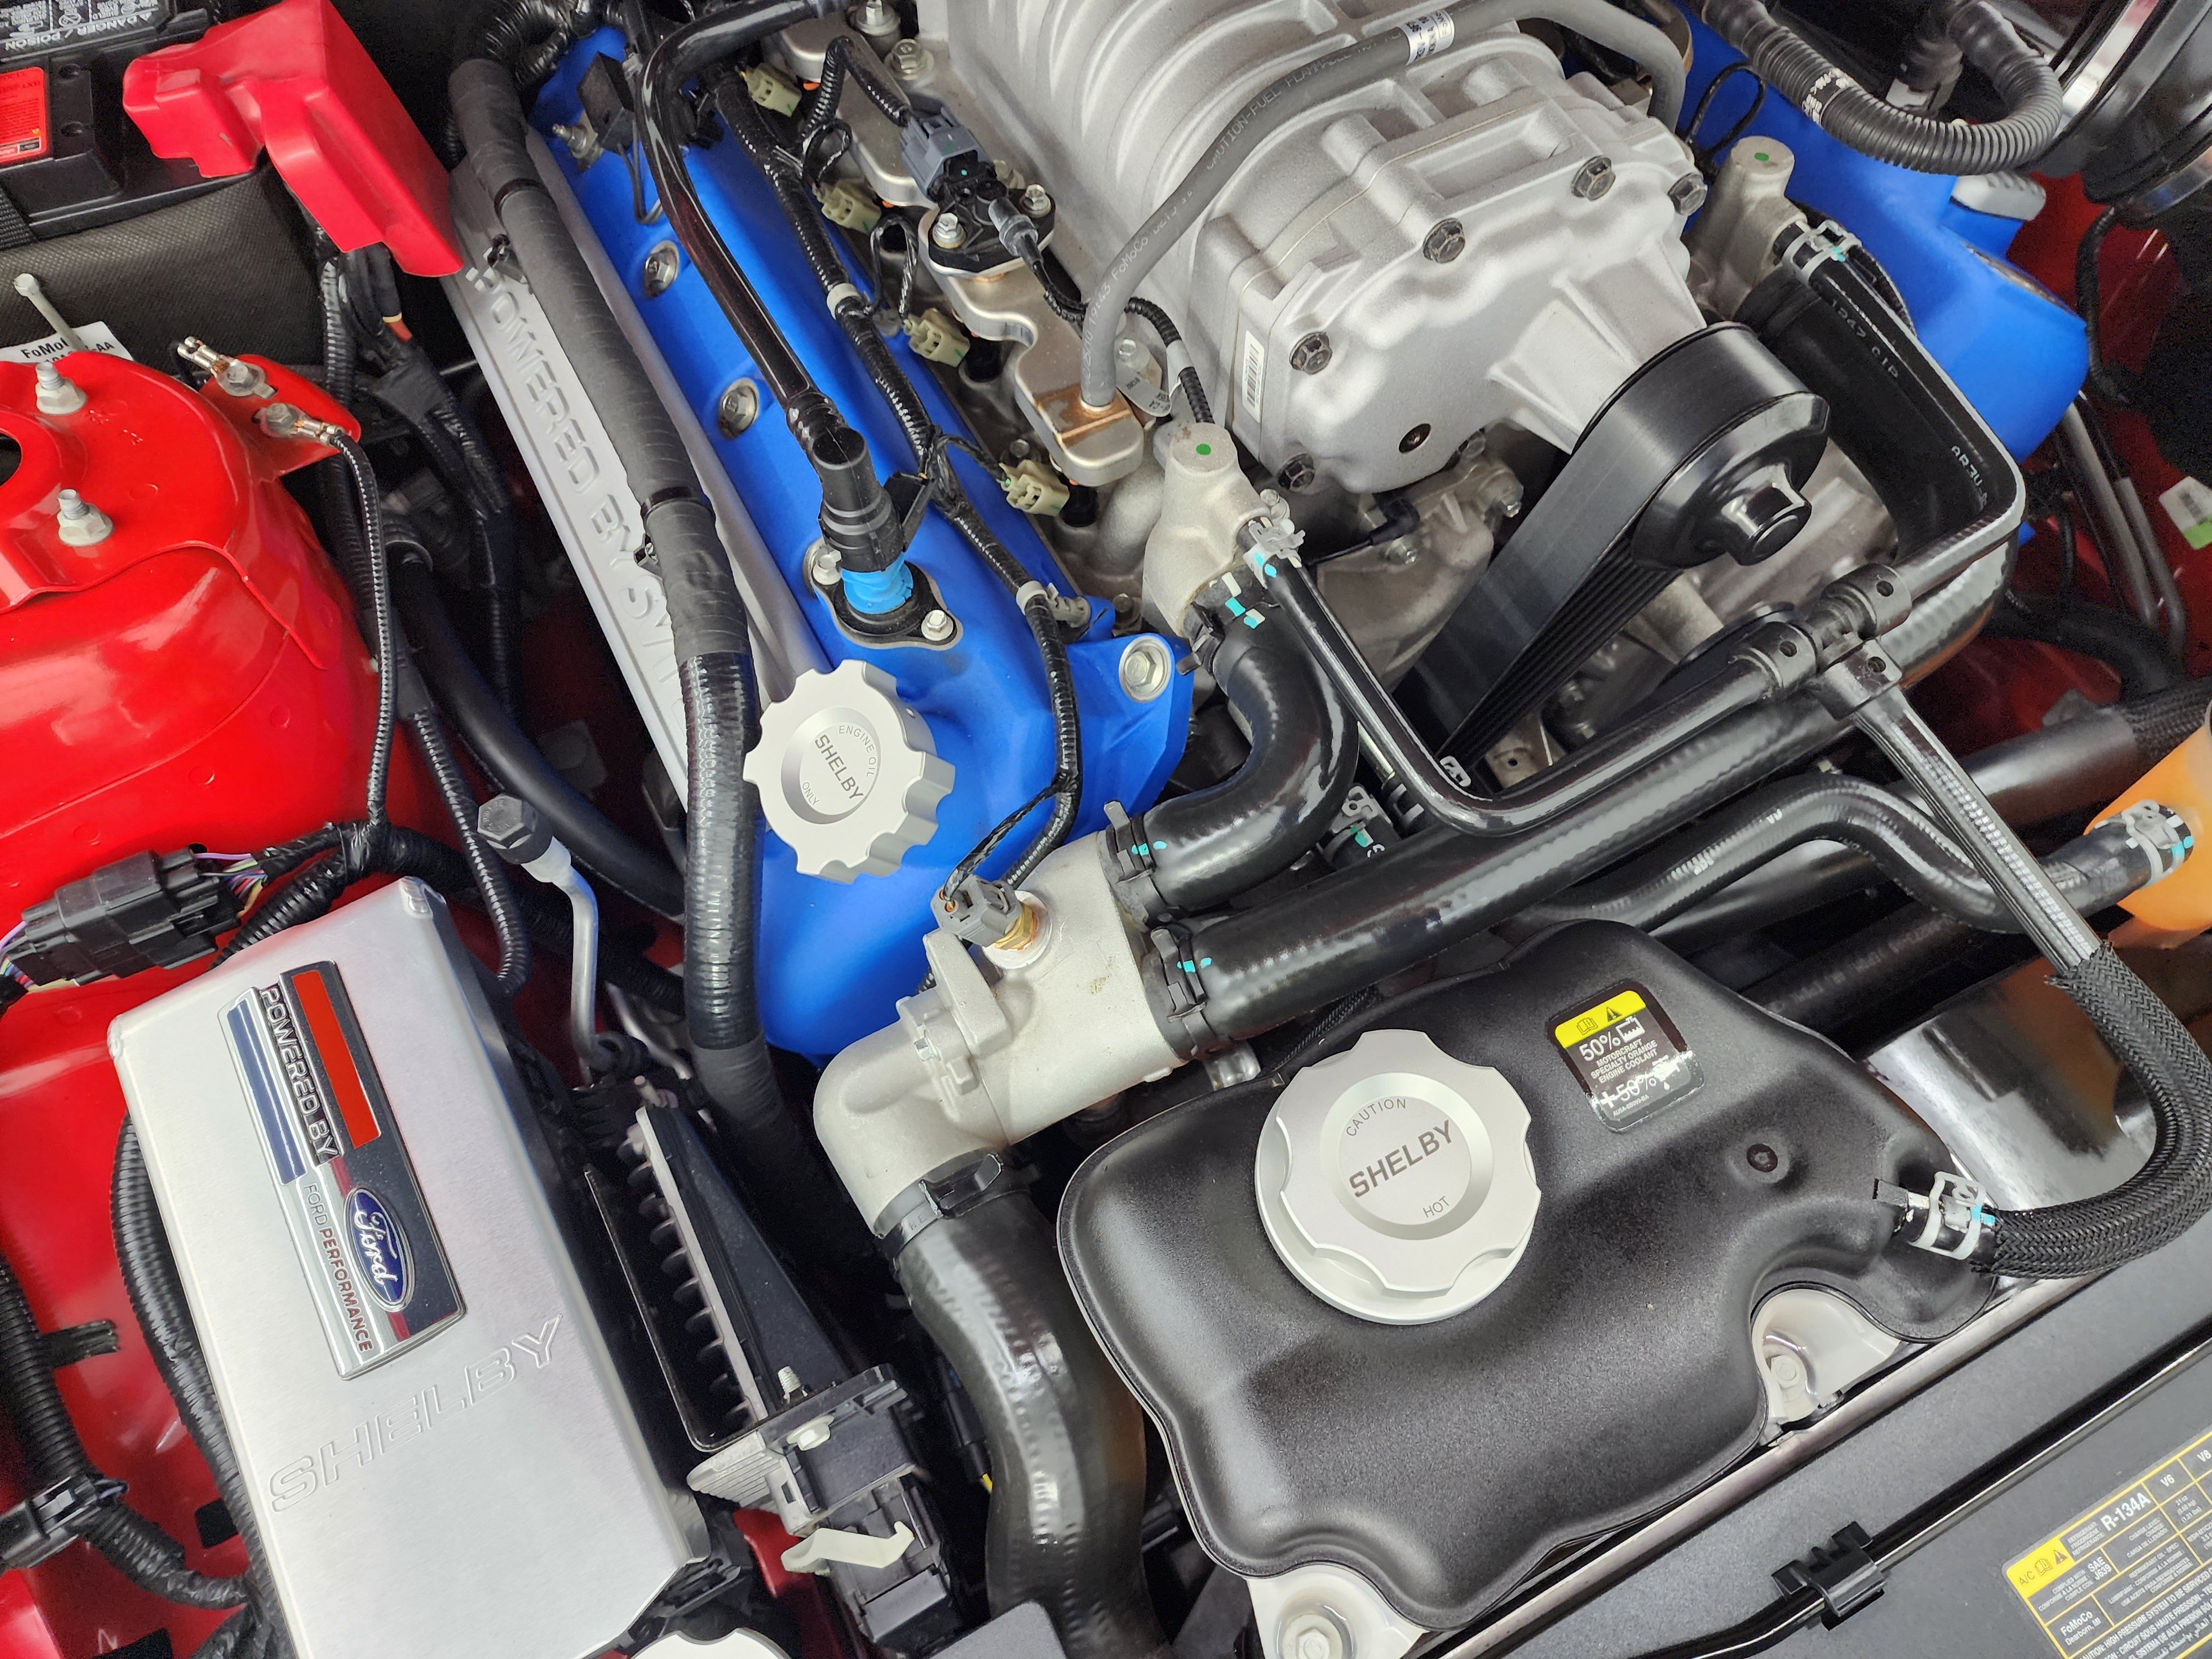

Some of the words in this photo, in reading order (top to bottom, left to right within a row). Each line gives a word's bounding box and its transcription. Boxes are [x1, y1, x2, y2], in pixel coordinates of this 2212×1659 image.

[5, 31, 61, 50] POISON
[77, 16, 137, 35] DANGER
[1109, 234, 1151, 281] FoMoCo
[20, 337, 70, 358] FoMo
[589, 493, 640, 575] BY
[815, 734, 864, 800] SHELBY
[838, 725, 875, 753] ENGINE
[866, 757, 877, 778] OIL
[802, 781, 820, 806] ONLY
[1578, 1031, 1622, 1061] 50%
[1589, 1053, 1628, 1079] SPECIALTY
[1627, 1039, 1658, 1061] ORANGE
[1595, 1038, 1643, 1067] MOTORCRAFT
[262, 988, 319, 1115] POWERED
[306, 1118, 340, 1156] BY
[1597, 1065, 1625, 1084] ENGINE
[1624, 1048, 1658, 1071] COOLANT
[1346, 1098, 1406, 1136] CAUTION
[1349, 1119, 1452, 1198] SHELBY
[1423, 1196, 1450, 1218] HOT
[354, 1209, 398, 1287] Ford
[303, 1183, 330, 1225] FORD
[319, 1227, 373, 1353] PERFORMANCE
[269, 1312, 563, 1512] SHELBY
[2197, 1450, 2211, 1462] V8
[2159, 1473, 2176, 1489] V6
[2099, 1489, 2152, 1532] R-134A
[2017, 1570, 2036, 1587] A/C
[2086, 1556, 2106, 1573] SAE
[2092, 1563, 2112, 1581] J639
[2059, 1608, 2094, 1637] FoMoCo
[2080, 1642, 2107, 1659] AUTION:
[2103, 1633, 2121, 1648] HIGH
[2116, 1613, 2149, 1640] PRESSURE
[2144, 1598, 2170, 1620] SYSTEM
[2165, 1593, 2177, 1605] TO
[2173, 1587, 2185, 1599] BE
[2181, 1569, 2212, 1594] SERVICED
[2117, 1634, 2143, 1655] CIRCUIT
[2138, 1623, 2158, 1641] SOUS
[2153, 1610, 2177, 1630] HAUTE
[2171, 1593, 2202, 1618] PRESSION
[2135, 1637, 2161, 1659] SISTEMA
[2157, 1631, 2169, 1644] DE
[2164, 1622, 2182, 1638] ALTA
[2176, 1606, 2204, 1629] PRESIÓN
[2064, 1621, 2095, 1646] Dearborn,
